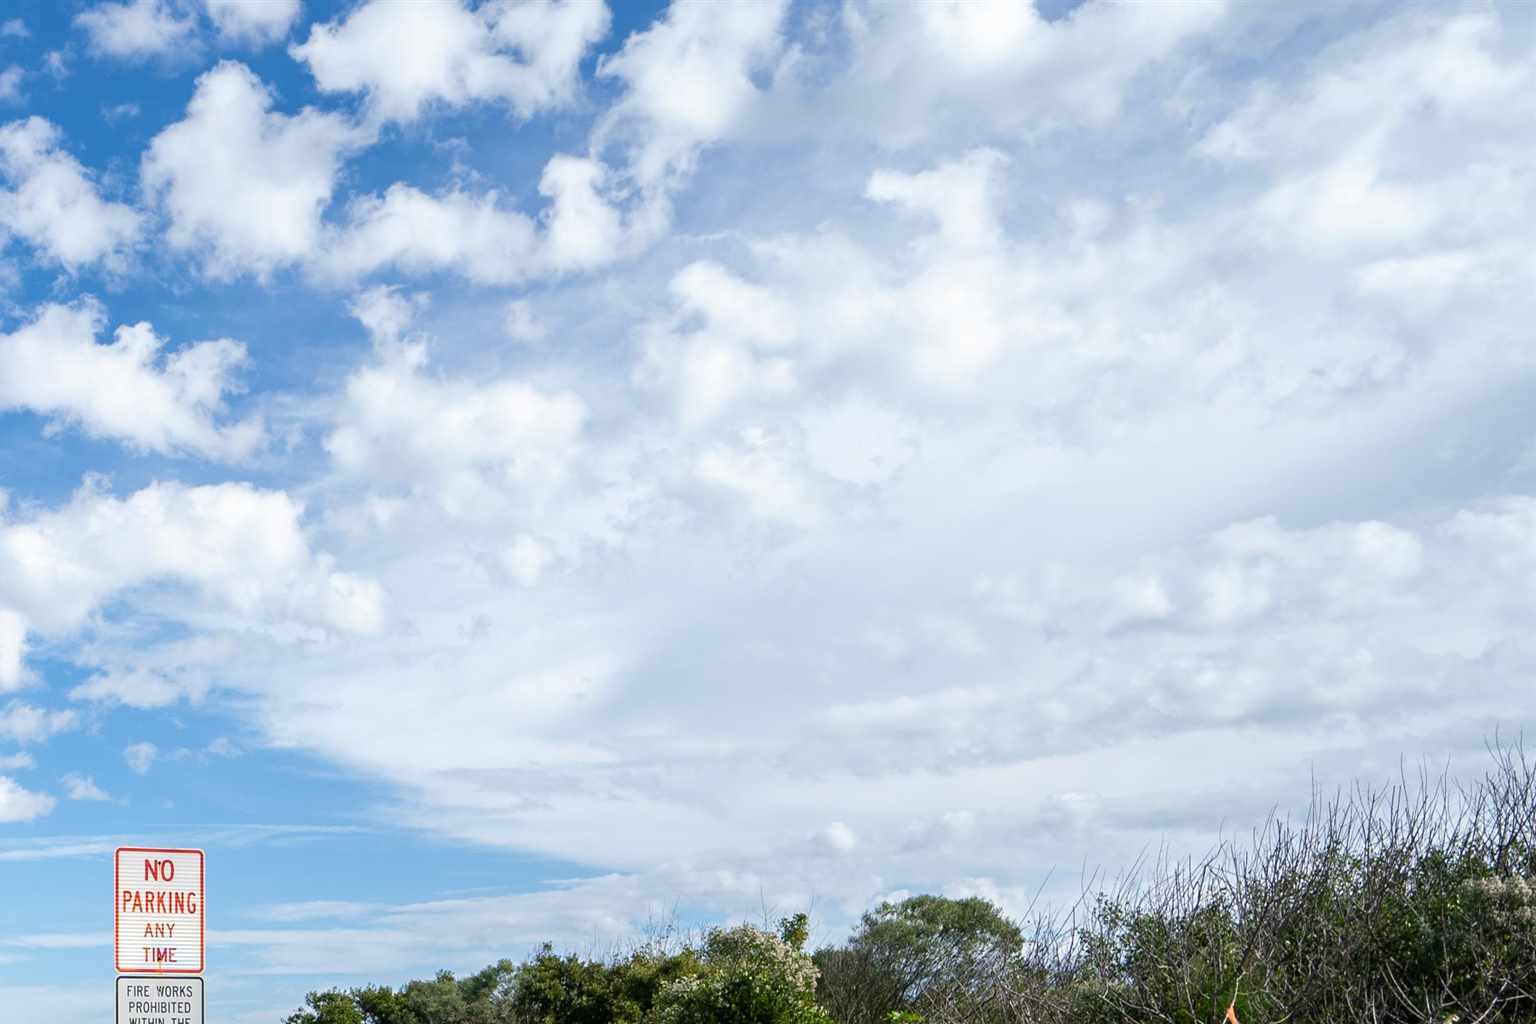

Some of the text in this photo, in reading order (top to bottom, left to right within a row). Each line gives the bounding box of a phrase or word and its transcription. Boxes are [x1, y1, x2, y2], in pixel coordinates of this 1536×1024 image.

[144, 859, 175, 882] NO
[122, 890, 196, 914] PARKING
[143, 922, 176, 938] ANY
[142, 947, 177, 963] TIME
[127, 985, 193, 998] FIRE WORKS
[128, 1001, 191, 1013] PROHIBITED
